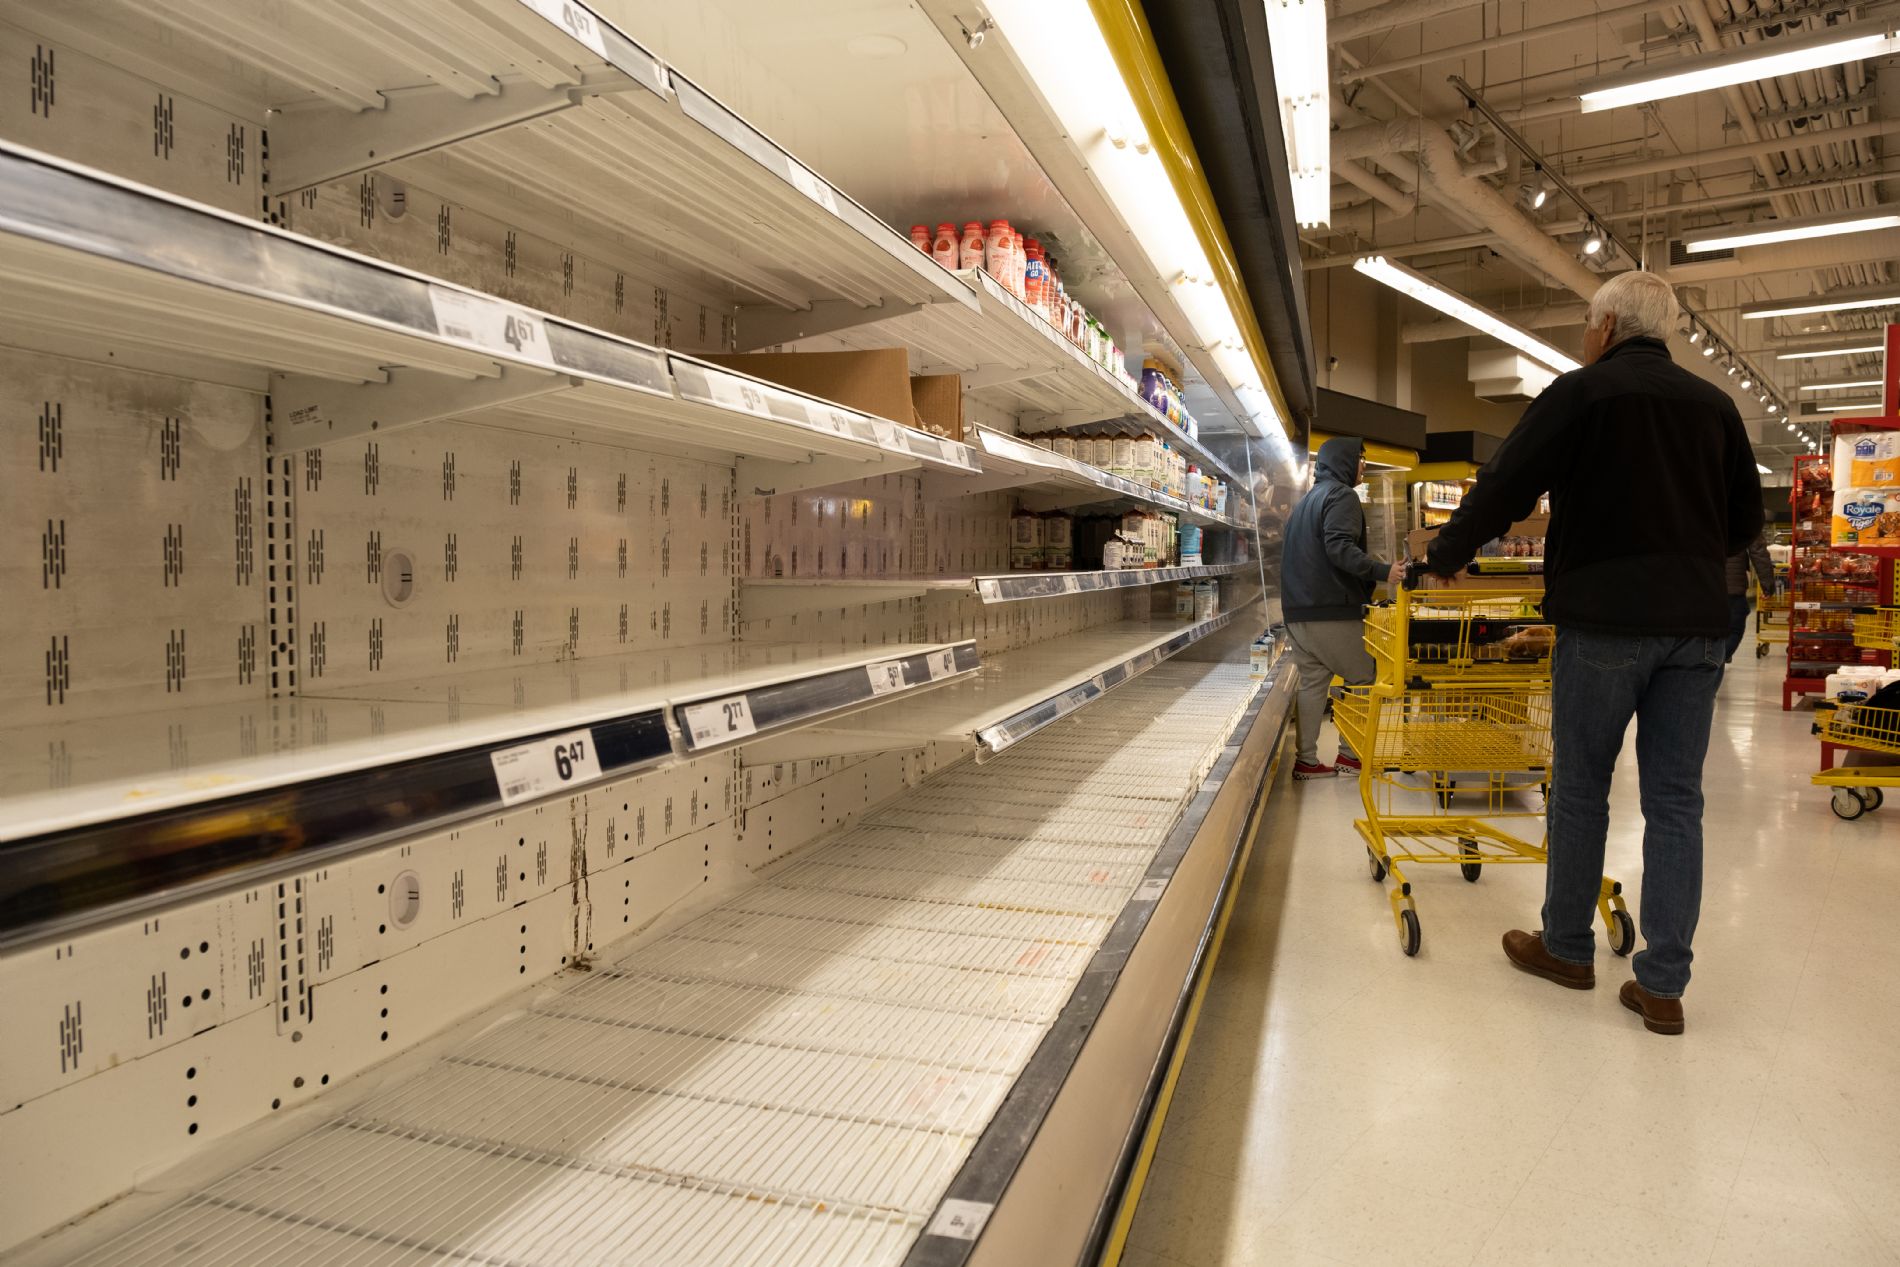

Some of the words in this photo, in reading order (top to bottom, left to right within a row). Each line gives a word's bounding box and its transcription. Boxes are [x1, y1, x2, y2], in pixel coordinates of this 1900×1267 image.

[504, 315, 535, 352] 467
[1846, 504, 1882, 517] Royale
[1847, 518, 1873, 530] Tiger
[723, 702, 743, 732] 277
[554, 740, 584, 781] 647
